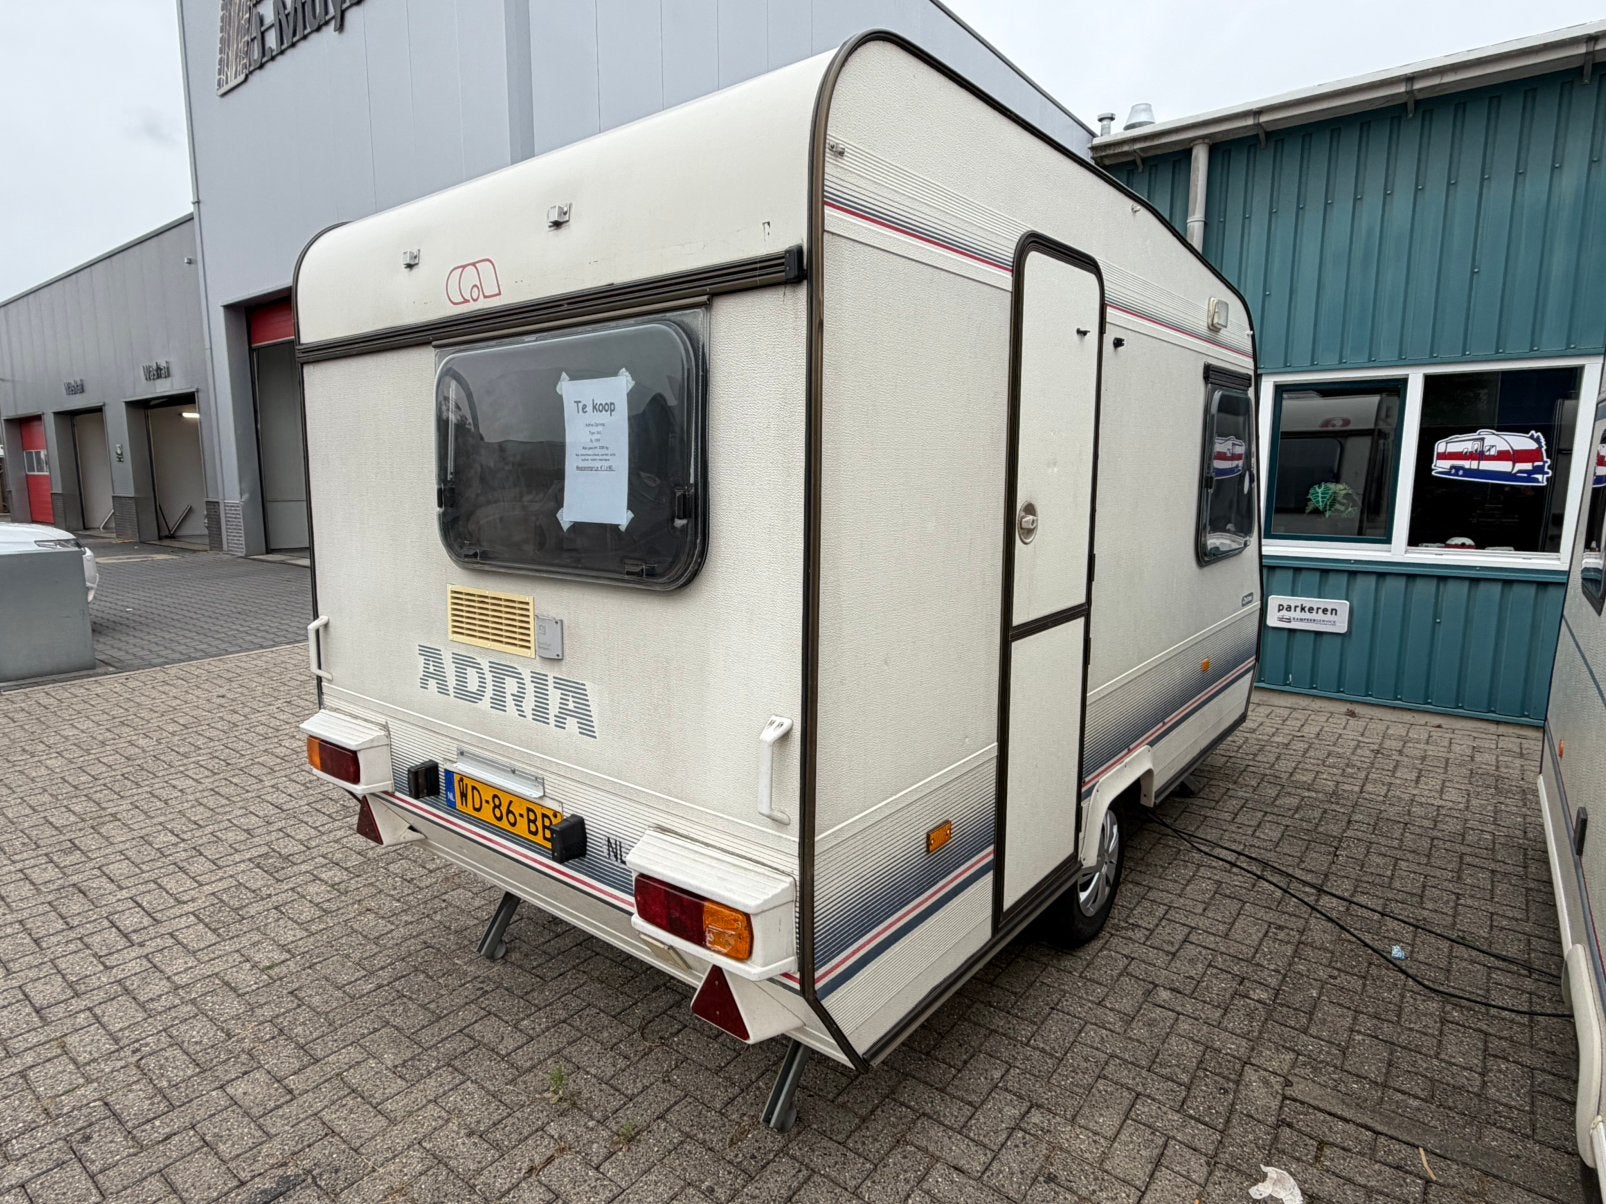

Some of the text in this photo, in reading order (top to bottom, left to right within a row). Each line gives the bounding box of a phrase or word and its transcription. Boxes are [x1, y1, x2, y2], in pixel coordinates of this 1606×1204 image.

[574, 399, 616, 417] Te koop
[1277, 603, 1338, 617] parkeren
[418, 644, 597, 739] ADRIA
[457, 778, 553, 843] WD-86-BB
